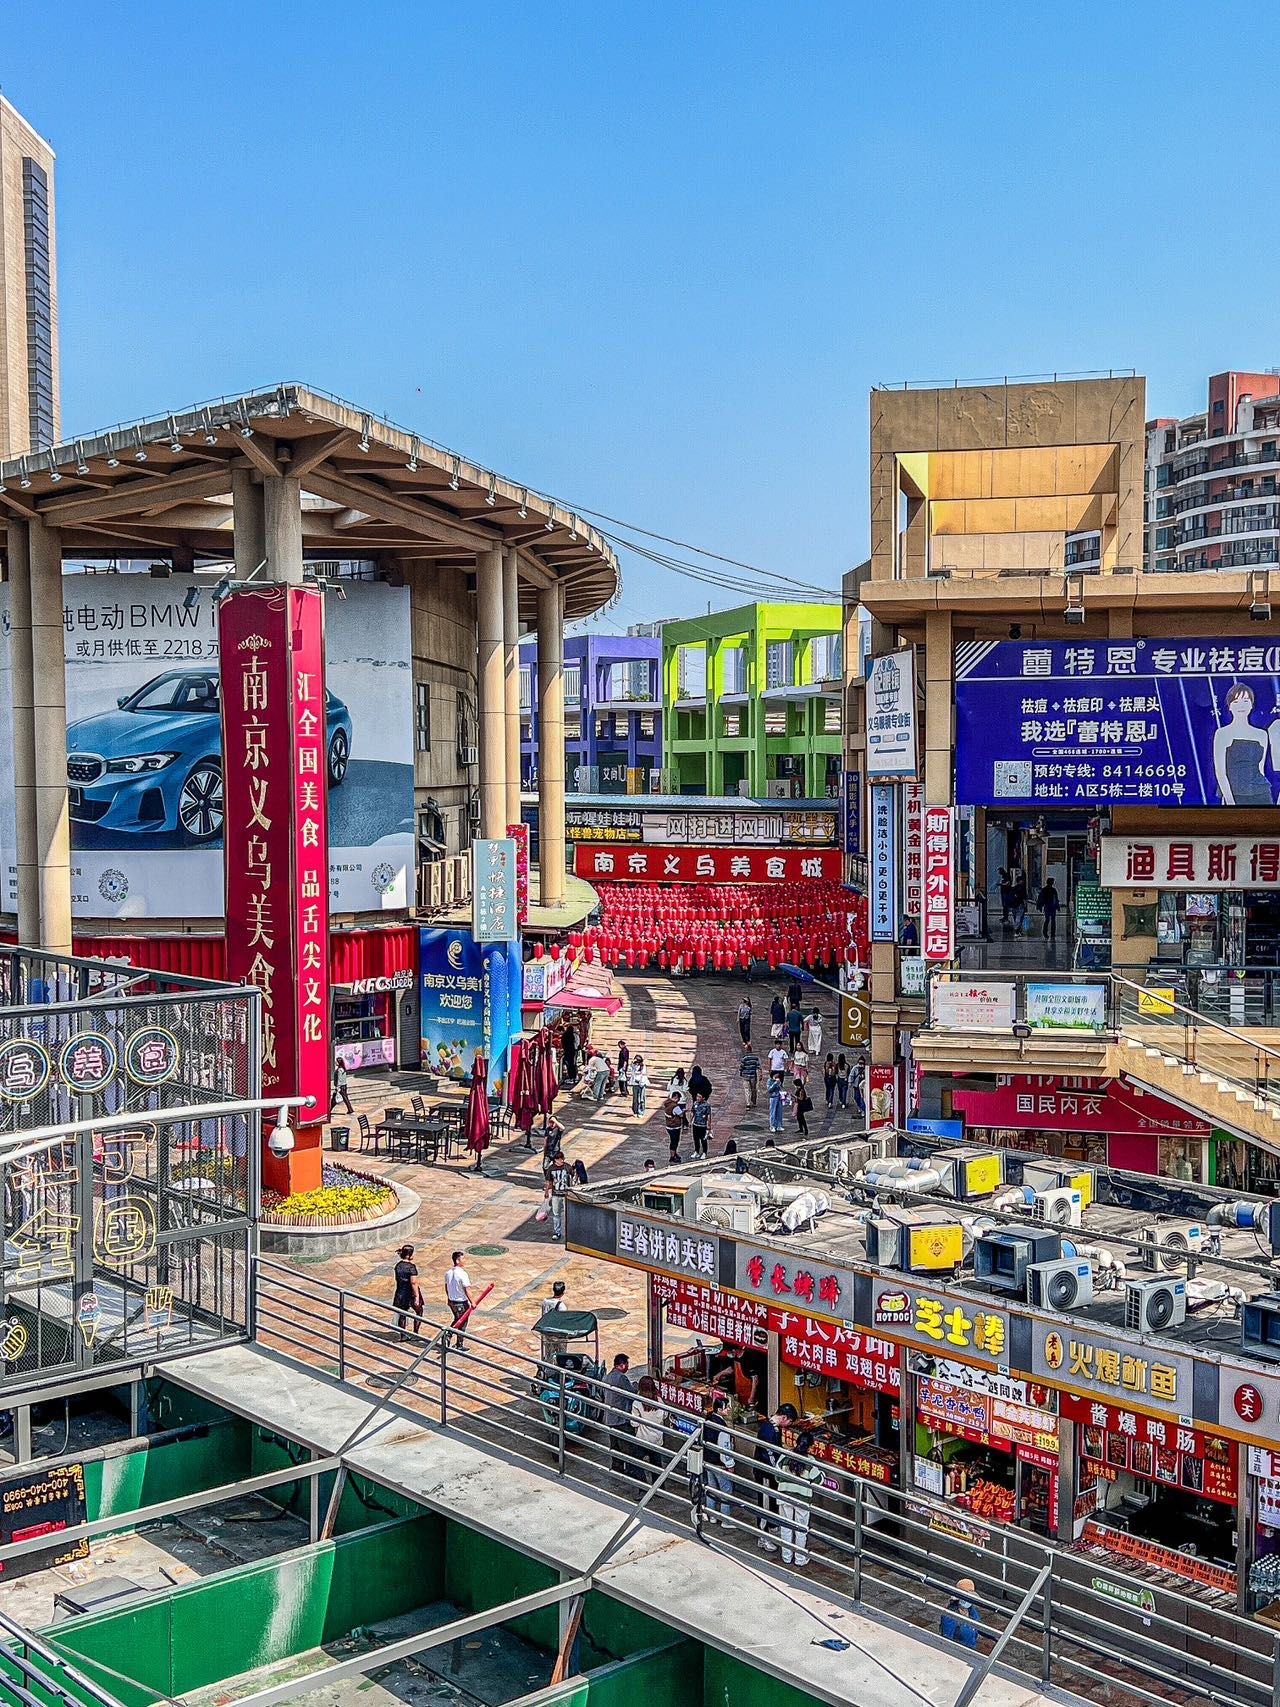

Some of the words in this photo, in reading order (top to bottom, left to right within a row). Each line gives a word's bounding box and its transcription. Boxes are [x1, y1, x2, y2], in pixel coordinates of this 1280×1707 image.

[76, 638, 159, 657] 或月供低至
[163, 640, 202, 655] 2218
[1022, 648, 1136, 675] 蕾特恩
[1151, 646, 1280, 673] 专业祛痘(
[1021, 698, 1048, 714] 祛痘
[1063, 697, 1103, 713] 祛痘印
[1119, 696, 1160, 713] 祛黑头
[1020, 720, 1158, 743] 我选『蕾特恩』
[297, 671, 320, 848] 汇全国美食
[1102, 764, 1187, 777] 84146698
[1075, 783, 1186, 798] A区5栋二楼10号
[566, 812, 642, 827] 玩猩娃娃机
[566, 827, 626, 840] 怪兽宠物店
[594, 852, 823, 879] 南京义乌美食城
[926, 813, 950, 952] 斯得户外渔具店
[301, 869, 323, 1043] 品舌尖文化
[352, 976, 388, 995] KFC
[439, 993, 473, 1010] 欢迎您
[848, 1007, 862, 1029] 9
[1016, 1094, 1102, 1116] 国民内衣
[618, 1220, 716, 1276] 里脊饼肉夹馍
[914, 1296, 1006, 1356] 芝士棒
[785, 1335, 837, 1368] 烤大肉串
[846, 1353, 900, 1387] 鸡翅包饭
[1068, 1339, 1178, 1401] 火爆鱿鱼
[1240, 1387, 1255, 1419] 天天
[1090, 1402, 1196, 1454] 酱爆鸭肠
[831, 1447, 885, 1480] 学长烤蹄
